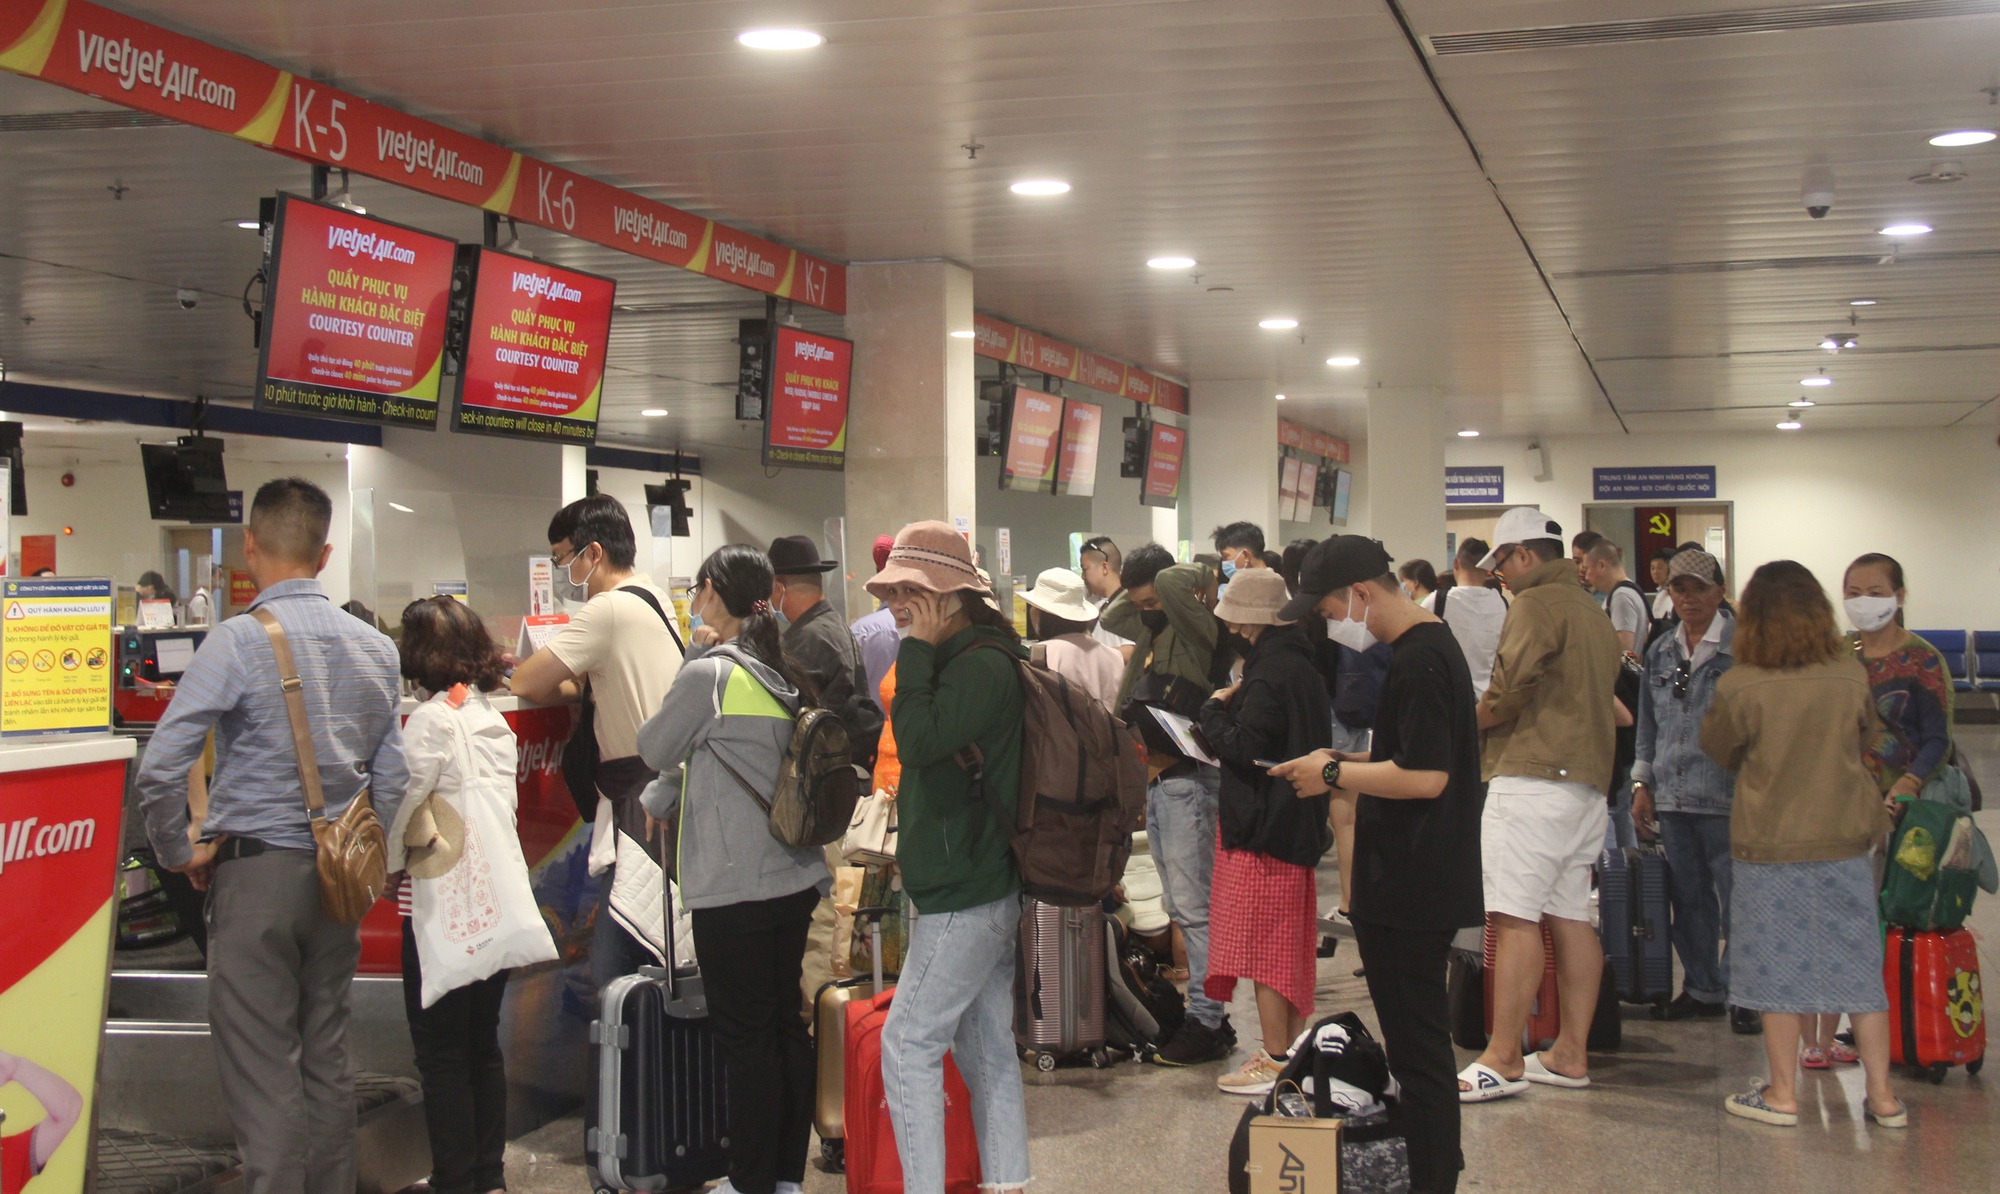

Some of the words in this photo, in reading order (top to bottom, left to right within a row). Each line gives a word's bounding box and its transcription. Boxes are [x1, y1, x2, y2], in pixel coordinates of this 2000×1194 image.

[294, 83, 347, 161] K-5
[538, 167, 575, 230] K-6
[328, 268, 359, 291] QUẦY
[362, 277, 390, 299] PHỤC
[394, 284, 409, 304] VỤ
[805, 259, 827, 306] K-7
[301, 285, 337, 310] HÀNH
[339, 295, 377, 318] KHÁCH
[379, 305, 401, 325] ĐẶC
[403, 308, 425, 330] BIỆT
[538, 314, 562, 334] PHỤC
[564, 320, 575, 337] VỤ
[309, 313, 365, 338] COURTESY
[367, 324, 414, 347] COUNTER
[490, 323, 517, 345] HÀNH
[519, 331, 550, 350] KHÁCH
[552, 338, 569, 356] ĐẶC
[571, 340, 588, 360] BIỆT
[496, 347, 540, 368] COURTESY
[542, 356, 579, 375] COUNTER
[275, 386, 296, 405] phút
[323, 394, 338, 410] giờ
[357, 396, 377, 413] hành
[382, 401, 415, 419] Check-in
[485, 414, 514, 429] counters
[528, 418, 544, 432] close
[546, 421, 552, 433] in
[552, 422, 562, 434] 40
[562, 424, 586, 437] minutes
[586, 426, 594, 438] be
